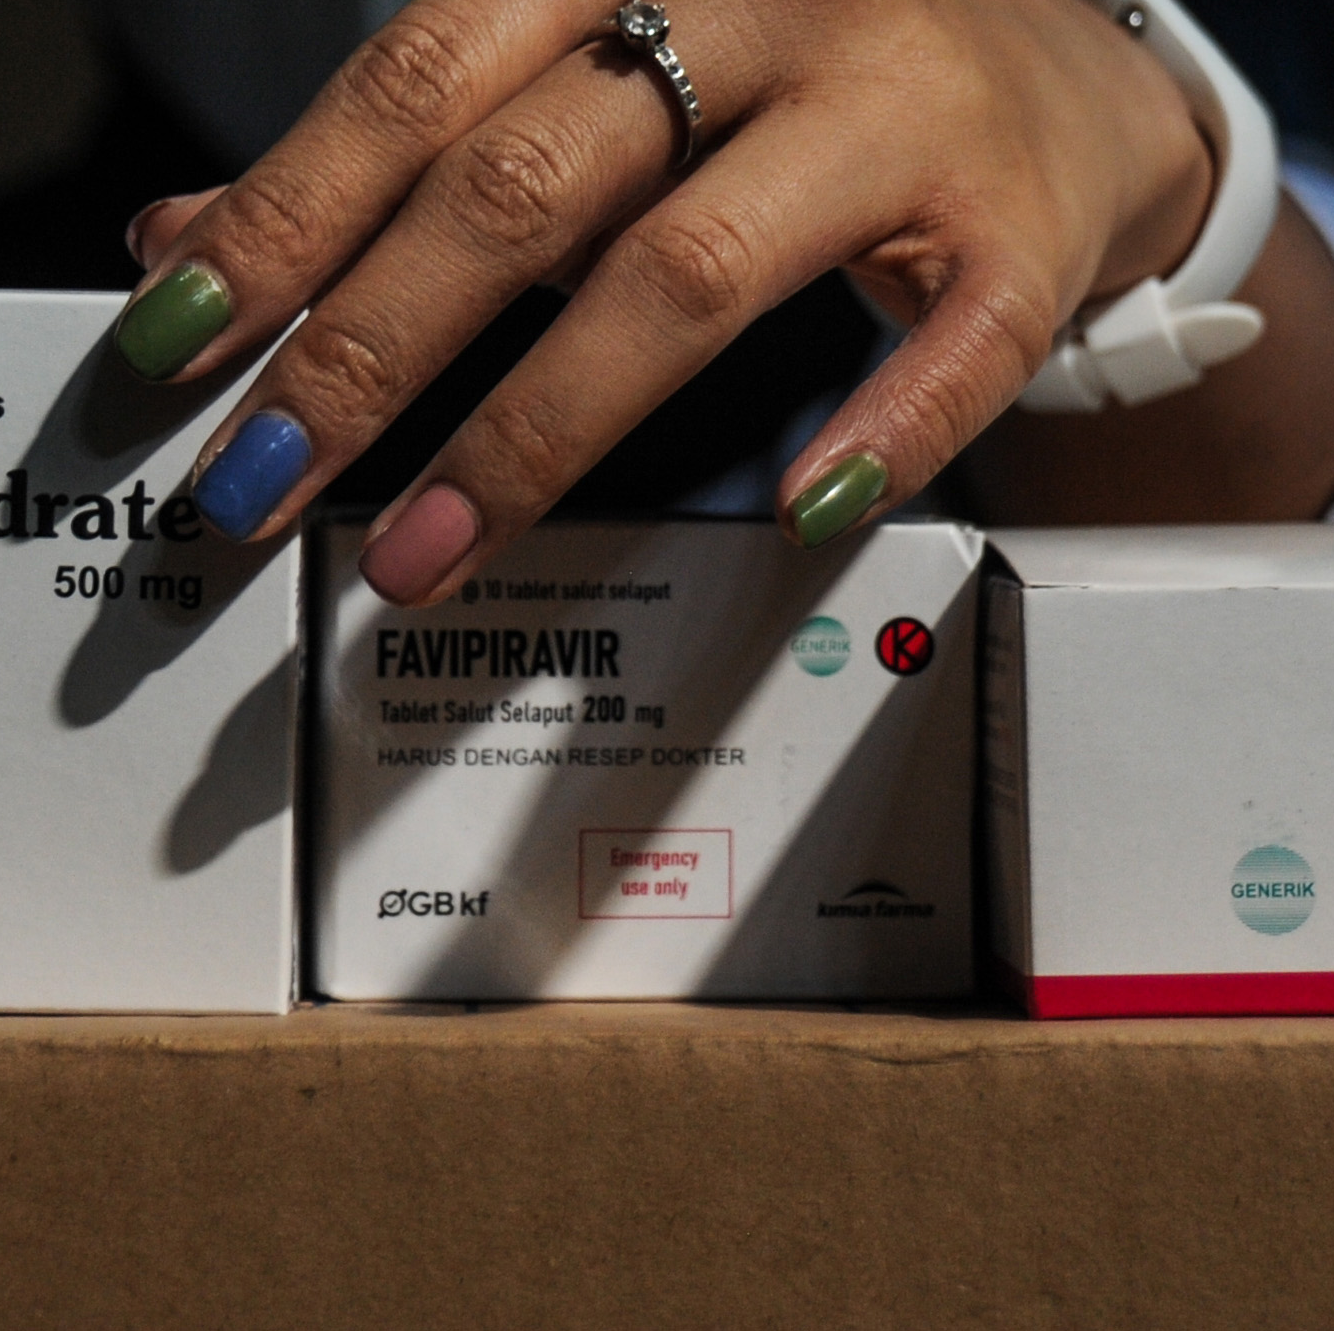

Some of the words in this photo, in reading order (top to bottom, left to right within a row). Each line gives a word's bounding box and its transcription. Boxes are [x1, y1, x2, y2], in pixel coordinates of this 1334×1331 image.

[53, 566, 127, 601] 500
[138, 573, 204, 612] mg
[507, 580, 556, 601] tablet
[562, 580, 604, 600] salut
[609, 580, 671, 605] selaput
[376, 628, 621, 679] FAVIPIRAVIR
[791, 639, 851, 654] GENERIK
[379, 699, 440, 725] Tablet
[443, 699, 495, 725] Salut
[500, 699, 574, 728] Selaput
[581, 694, 627, 724] 200
[634, 705, 666, 730] mg
[377, 746, 456, 767] HARUS
[464, 746, 561, 768] DENGAN
[568, 746, 644, 768] RESEP
[650, 744, 745, 768] DOKTER
[609, 845, 699, 871] Emergency
[620, 881, 649, 896] use
[654, 877, 689, 900] only
[1230, 882, 1315, 899] GENERIK
[460, 891, 489, 917] kf
